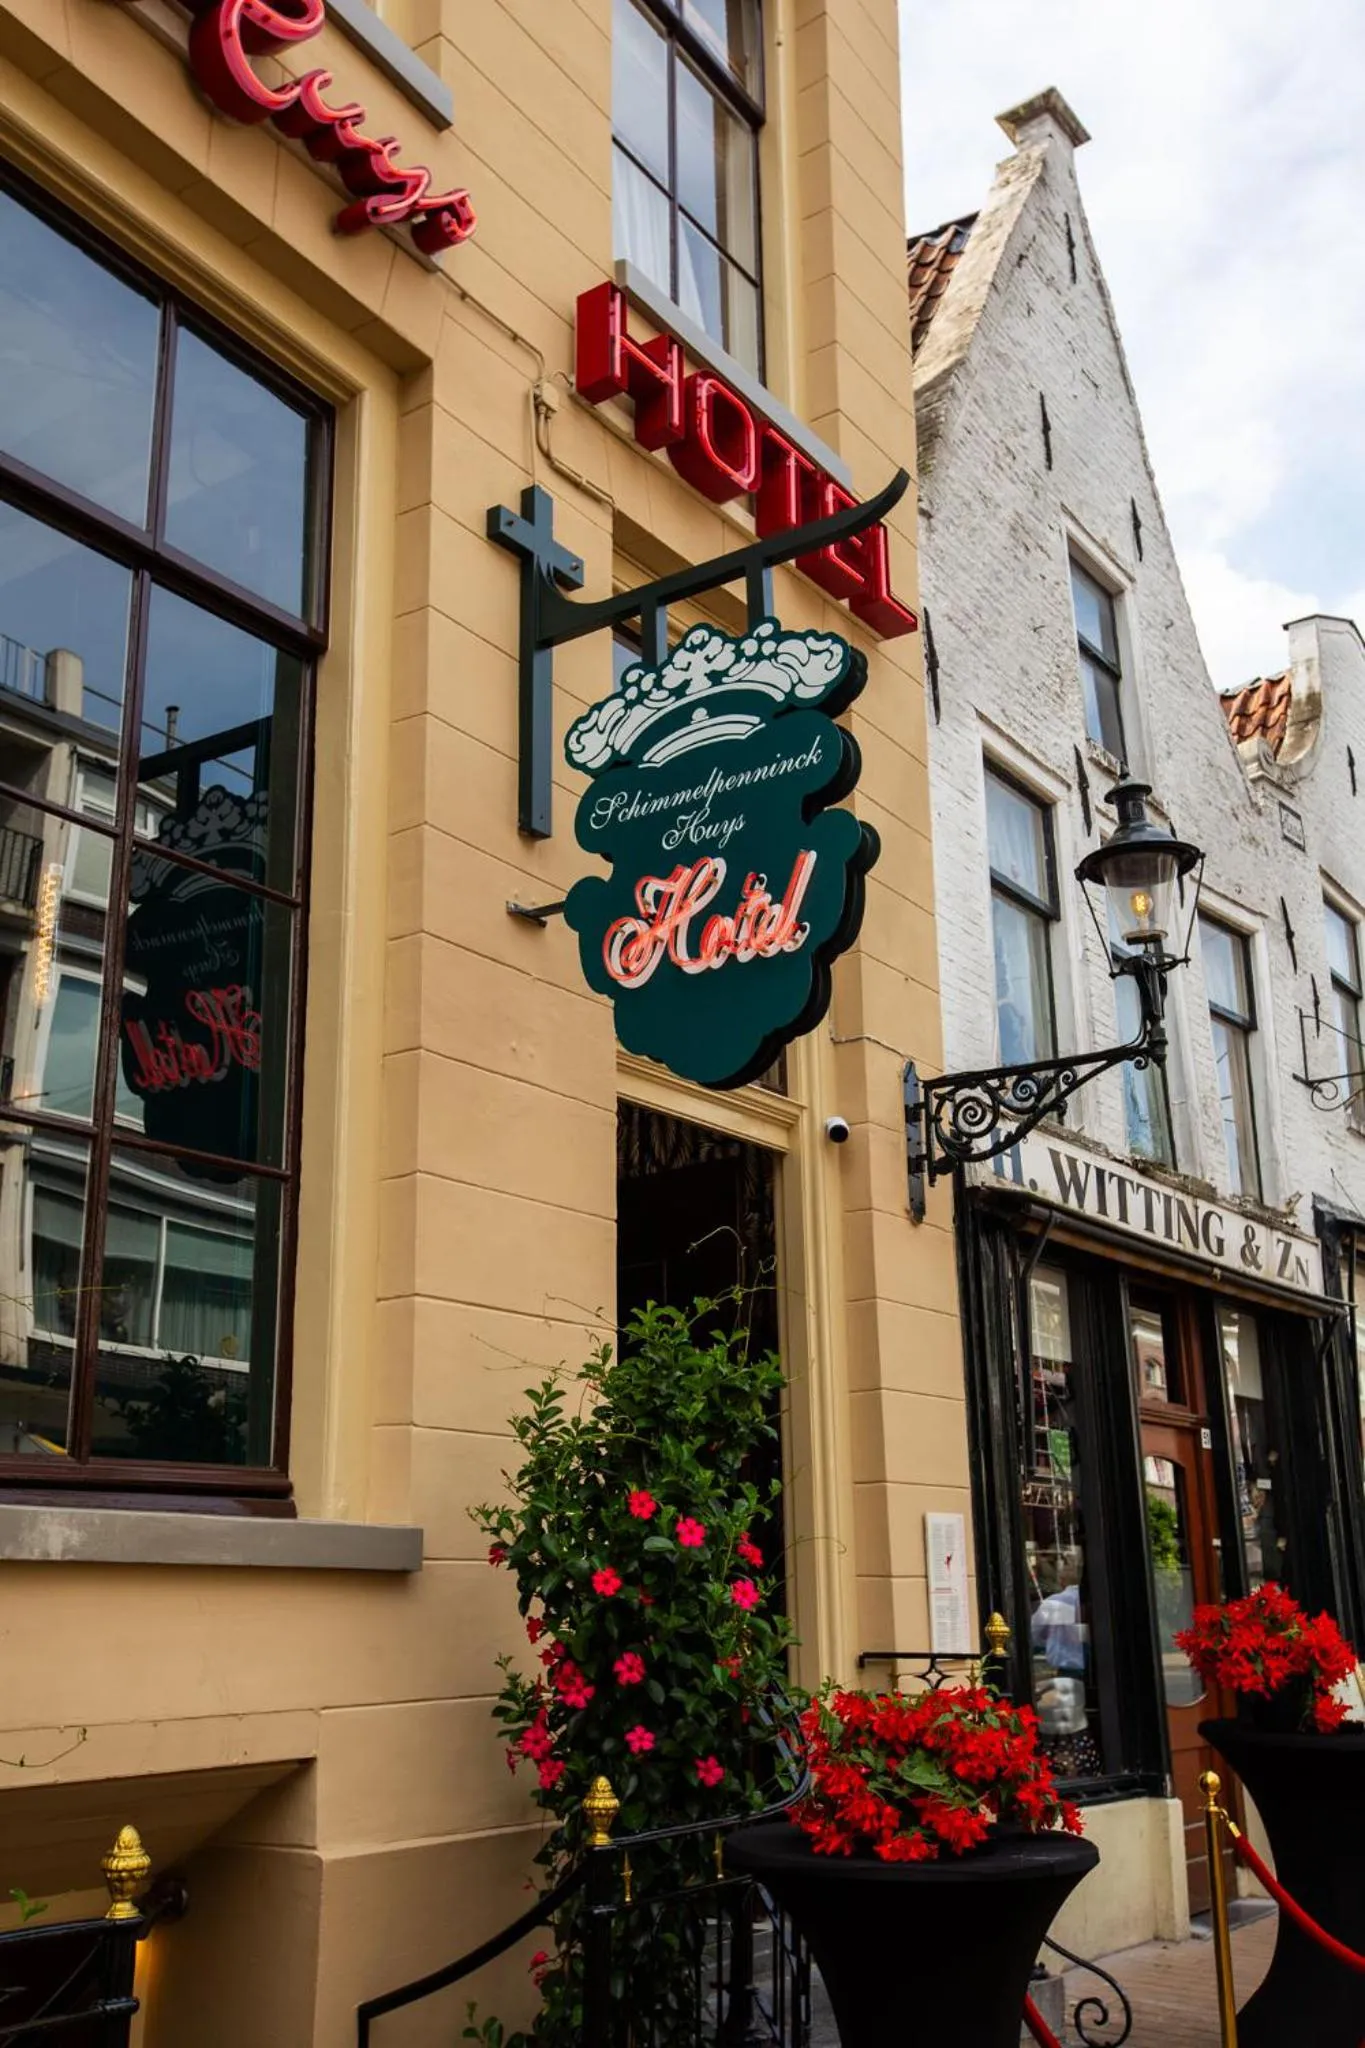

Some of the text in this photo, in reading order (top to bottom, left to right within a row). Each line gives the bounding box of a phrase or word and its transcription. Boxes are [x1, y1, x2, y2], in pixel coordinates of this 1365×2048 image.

[577, 281, 918, 641] HOTEL
[589, 735, 823, 831] Schimmelpenninck
[661, 807, 745, 850] Huys
[602, 850, 817, 989] Hotel
[1048, 1146, 1225, 1258] WITTING
[1240, 1224, 1263, 1271] &
